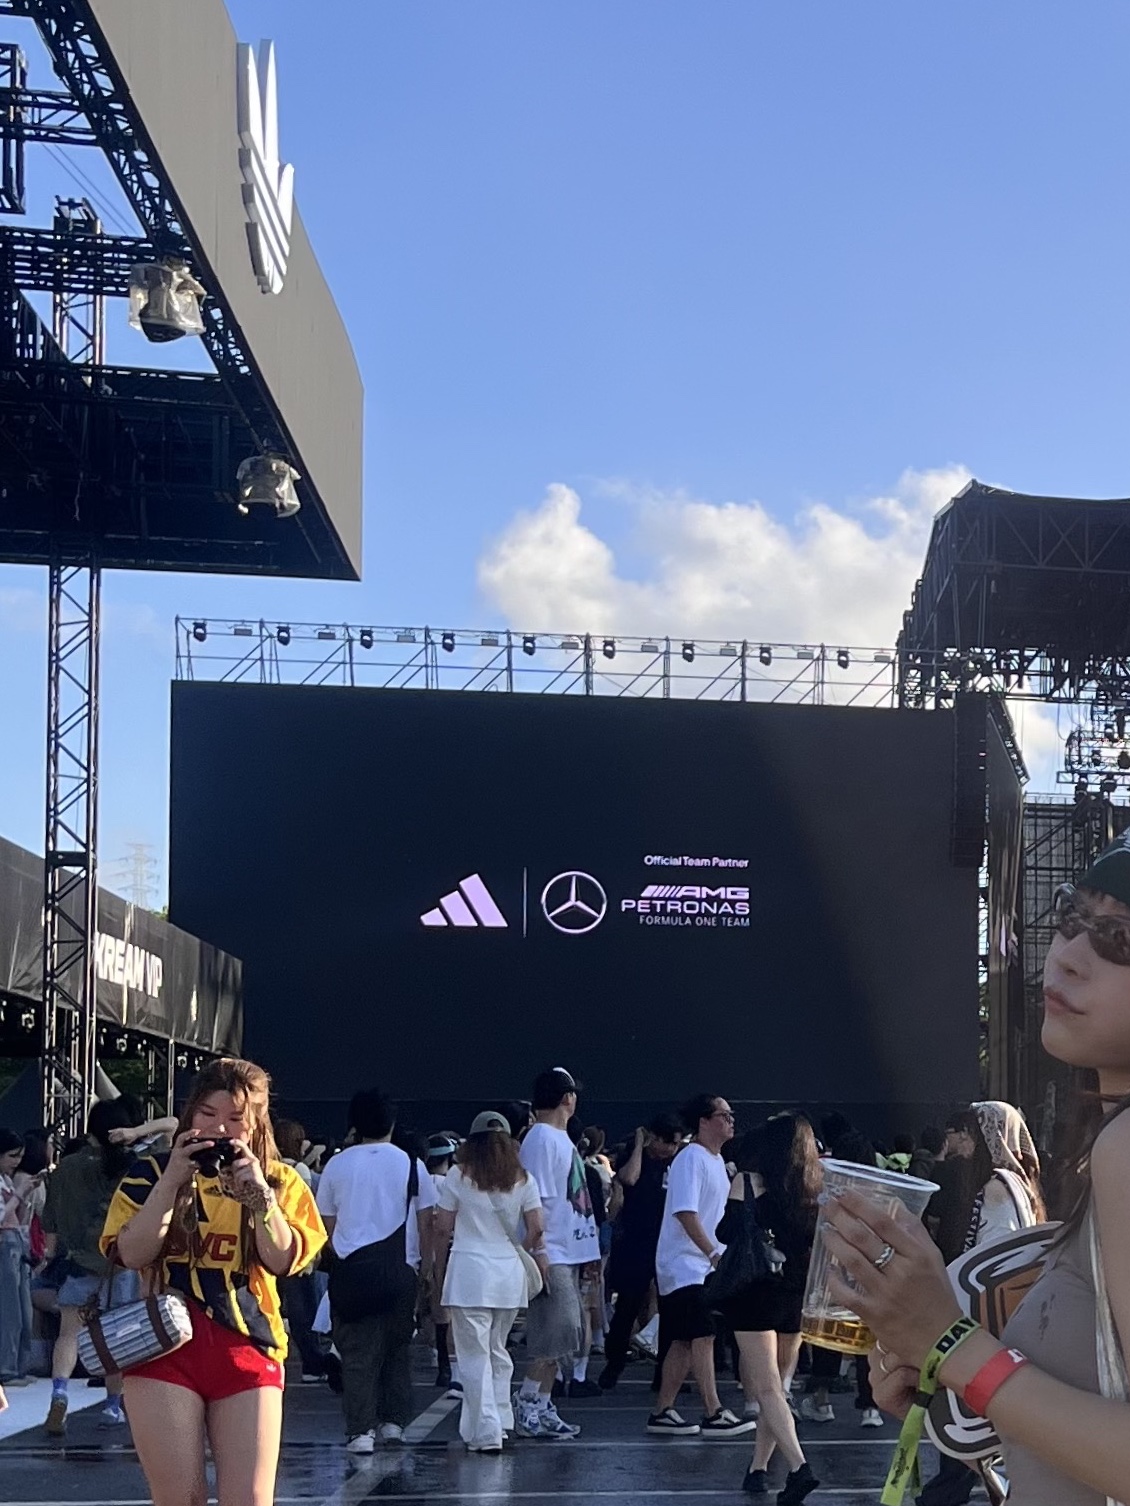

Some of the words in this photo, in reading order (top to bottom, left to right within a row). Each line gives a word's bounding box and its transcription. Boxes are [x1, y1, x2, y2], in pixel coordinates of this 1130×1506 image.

[644, 855, 682, 866] Official
[683, 856, 711, 867] Team
[712, 857, 749, 868] Partner
[621, 899, 750, 915] PETRONAS
[640, 915, 692, 926] FORMULA
[695, 917, 717, 926] ONE
[722, 917, 750, 927] TEAM
[963, 1199, 983, 1253] FESTIVA
